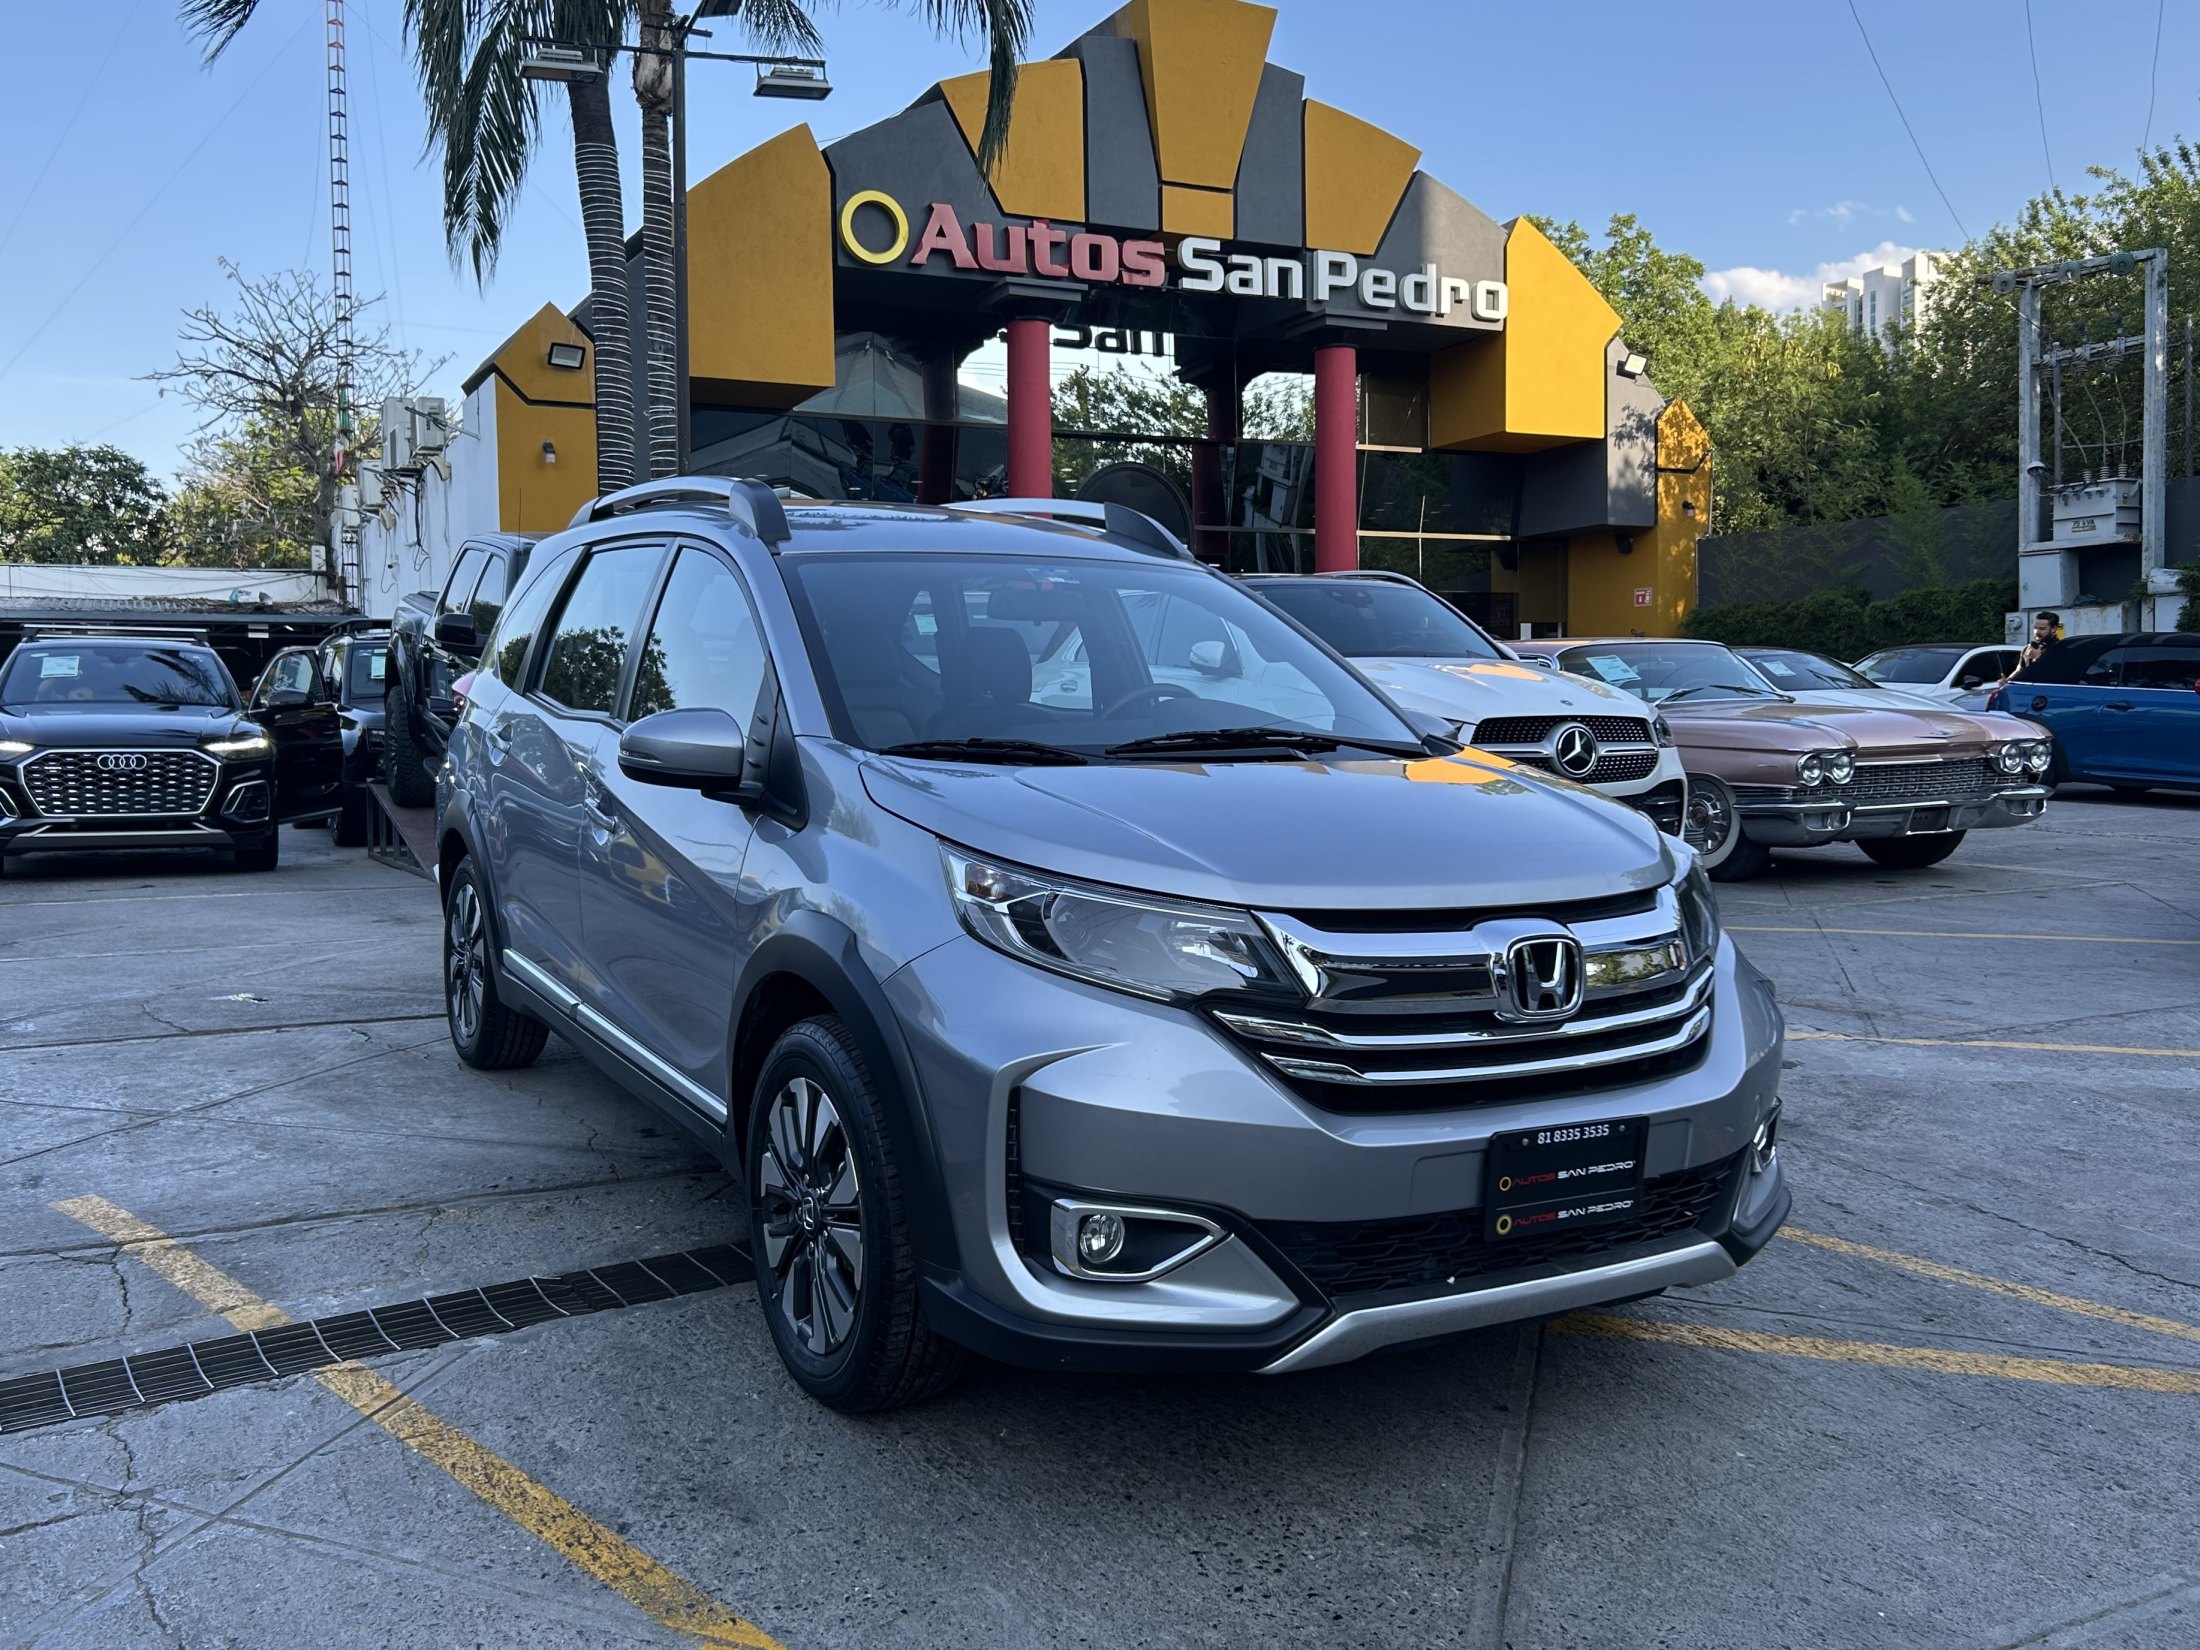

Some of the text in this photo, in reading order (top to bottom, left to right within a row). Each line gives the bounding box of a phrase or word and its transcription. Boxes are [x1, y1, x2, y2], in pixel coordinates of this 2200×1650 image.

[911, 203, 1509, 321] Autos San Pedro
[1537, 1124, 1610, 1145] 81 8335 3535
[1512, 1172, 1557, 1187] AUTOS
[1557, 1167, 1586, 1180] SAN
[1513, 1212, 1557, 1226] AUTOS
[1557, 1207, 1586, 1219] SAN
